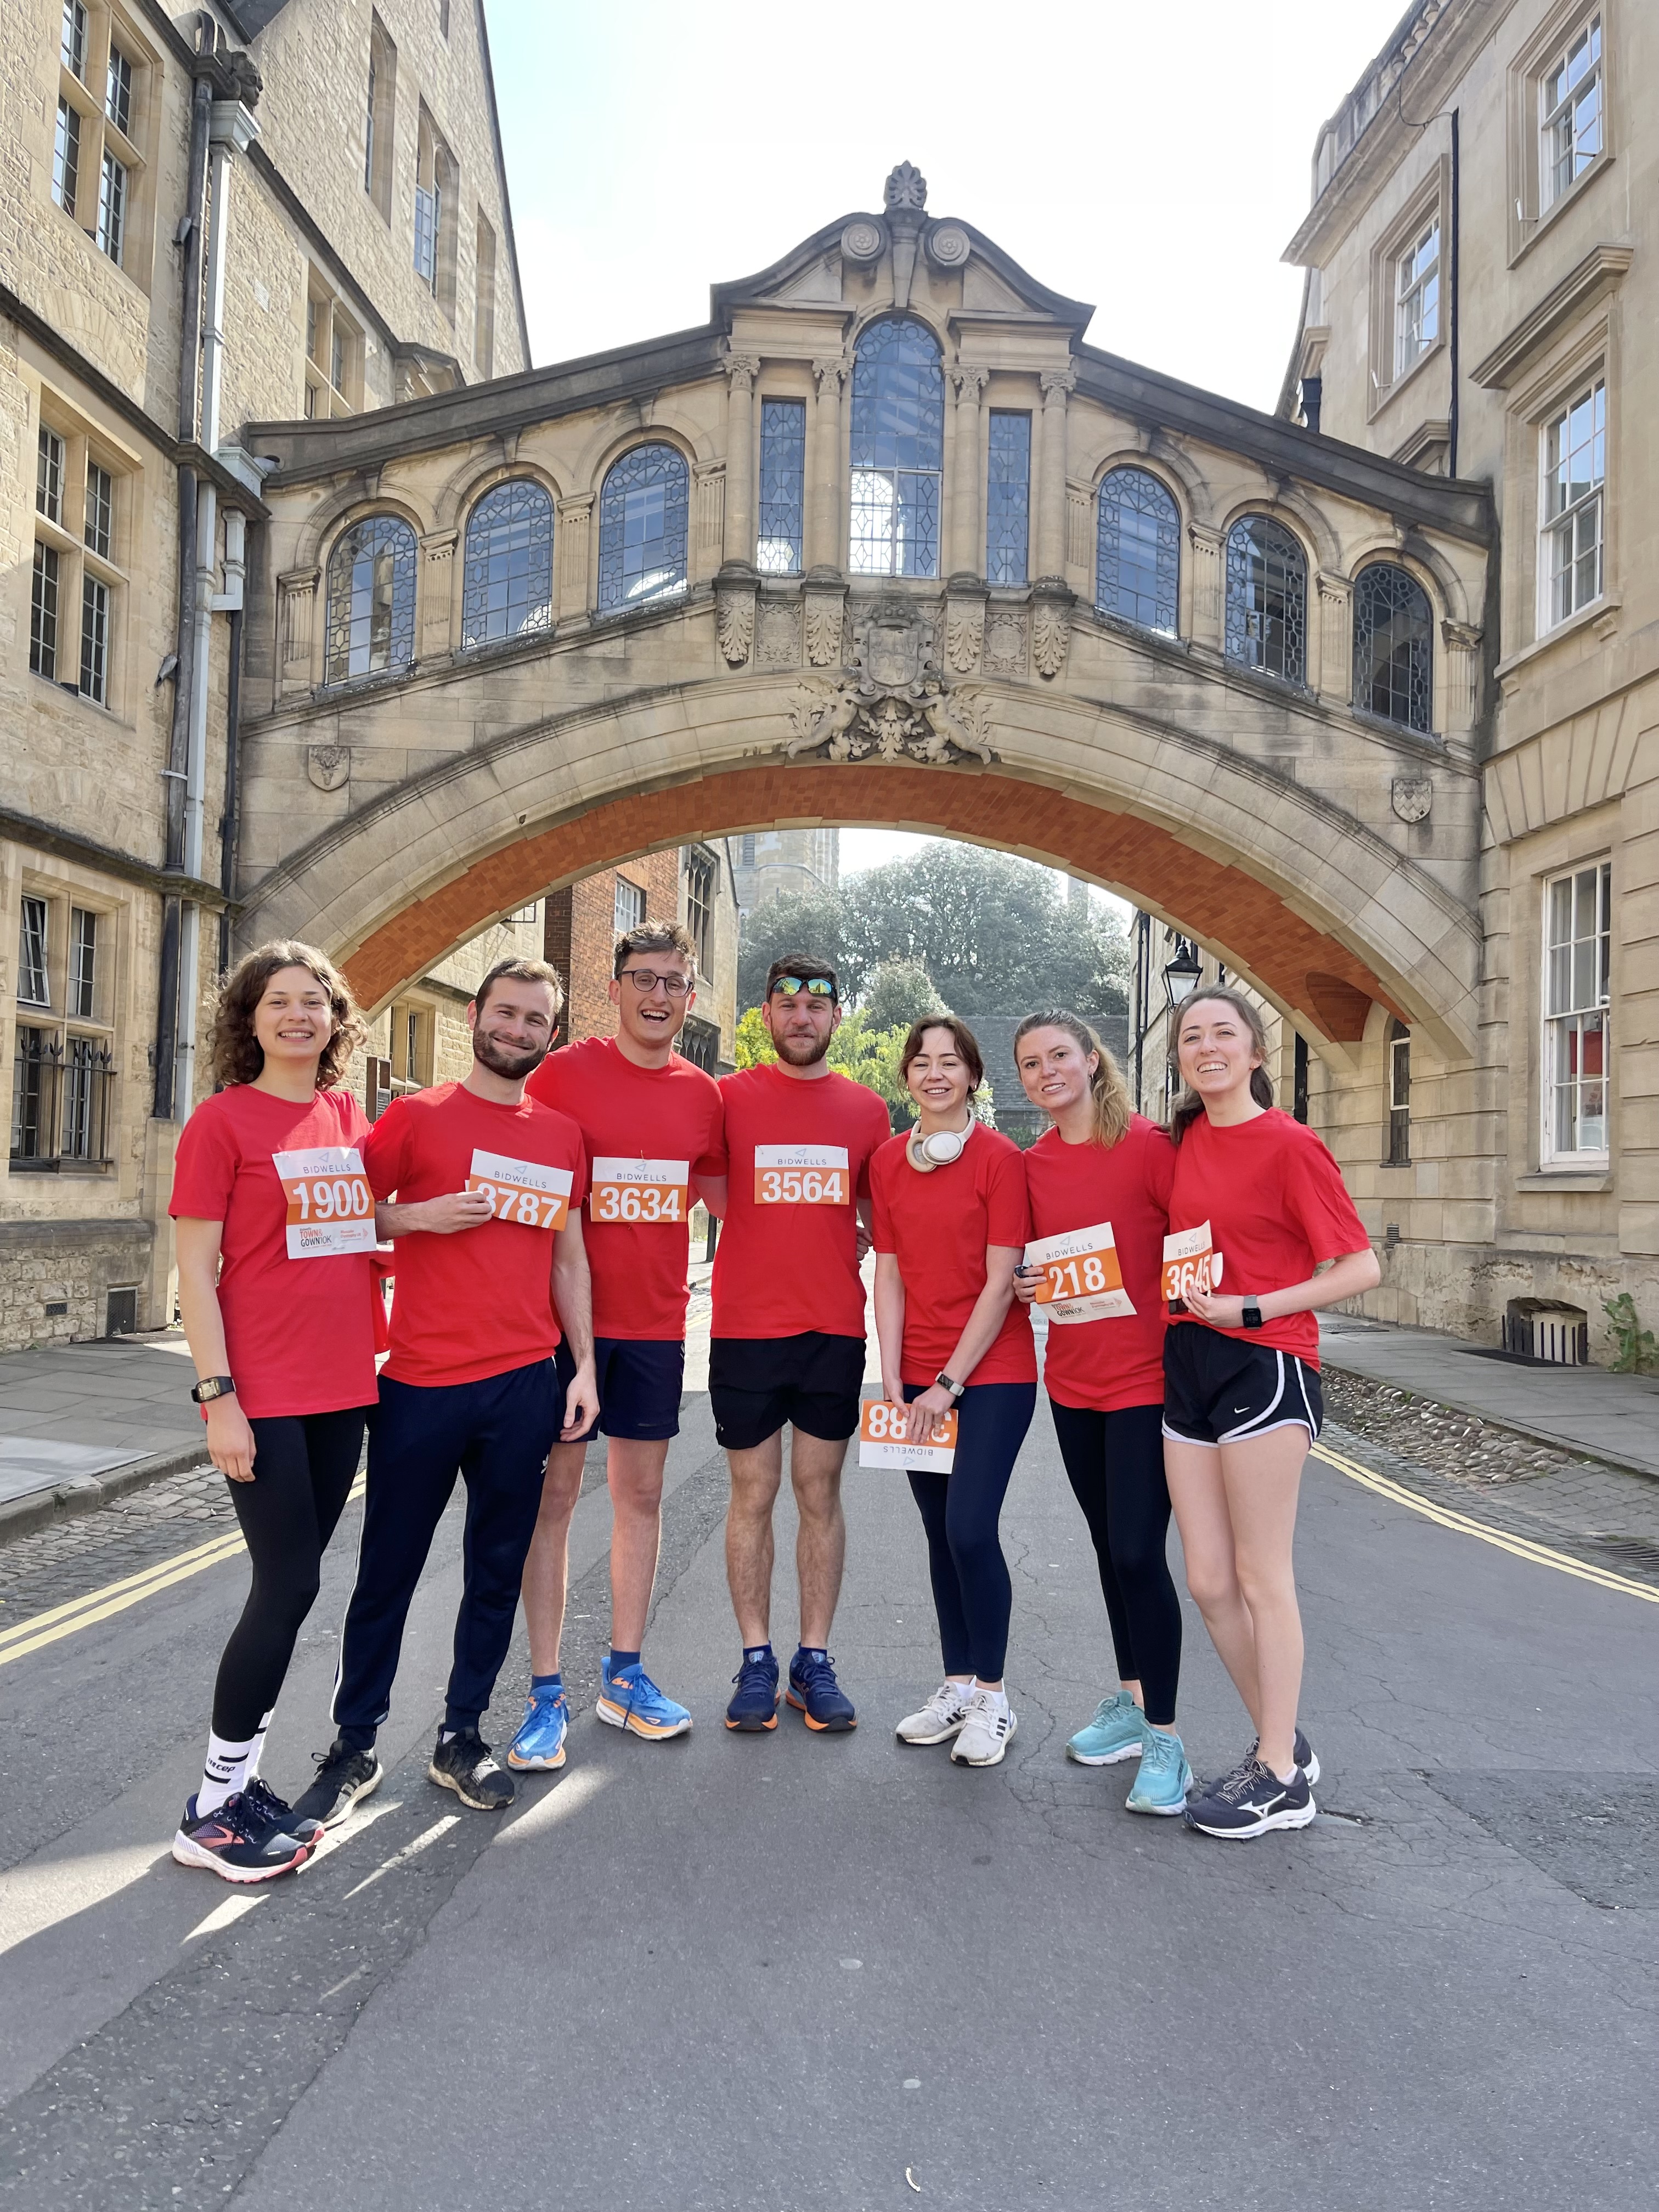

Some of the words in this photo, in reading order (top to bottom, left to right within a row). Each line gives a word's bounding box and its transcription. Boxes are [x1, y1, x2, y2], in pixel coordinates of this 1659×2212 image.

[303, 1164, 351, 1174] BIDWELLS
[617, 1173, 667, 1182] BIDWELLS
[494, 1171, 547, 1188] BIDWELLS
[761, 1171, 843, 1203] 3564
[292, 1180, 369, 1220] 1900
[599, 1187, 680, 1221] 3634
[300, 1229, 323, 1239] TOWN&
[1046, 1243, 1093, 1260] BIDWELLS
[1178, 1241, 1205, 1256] BIDWELLS
[1048, 1257, 1105, 1300] 218
[1166, 1254, 1211, 1300] 3645
[868, 1404, 952, 1443] 388
[883, 1446, 933, 1456] BIDWELLS
[216, 1764, 236, 1773] cep
